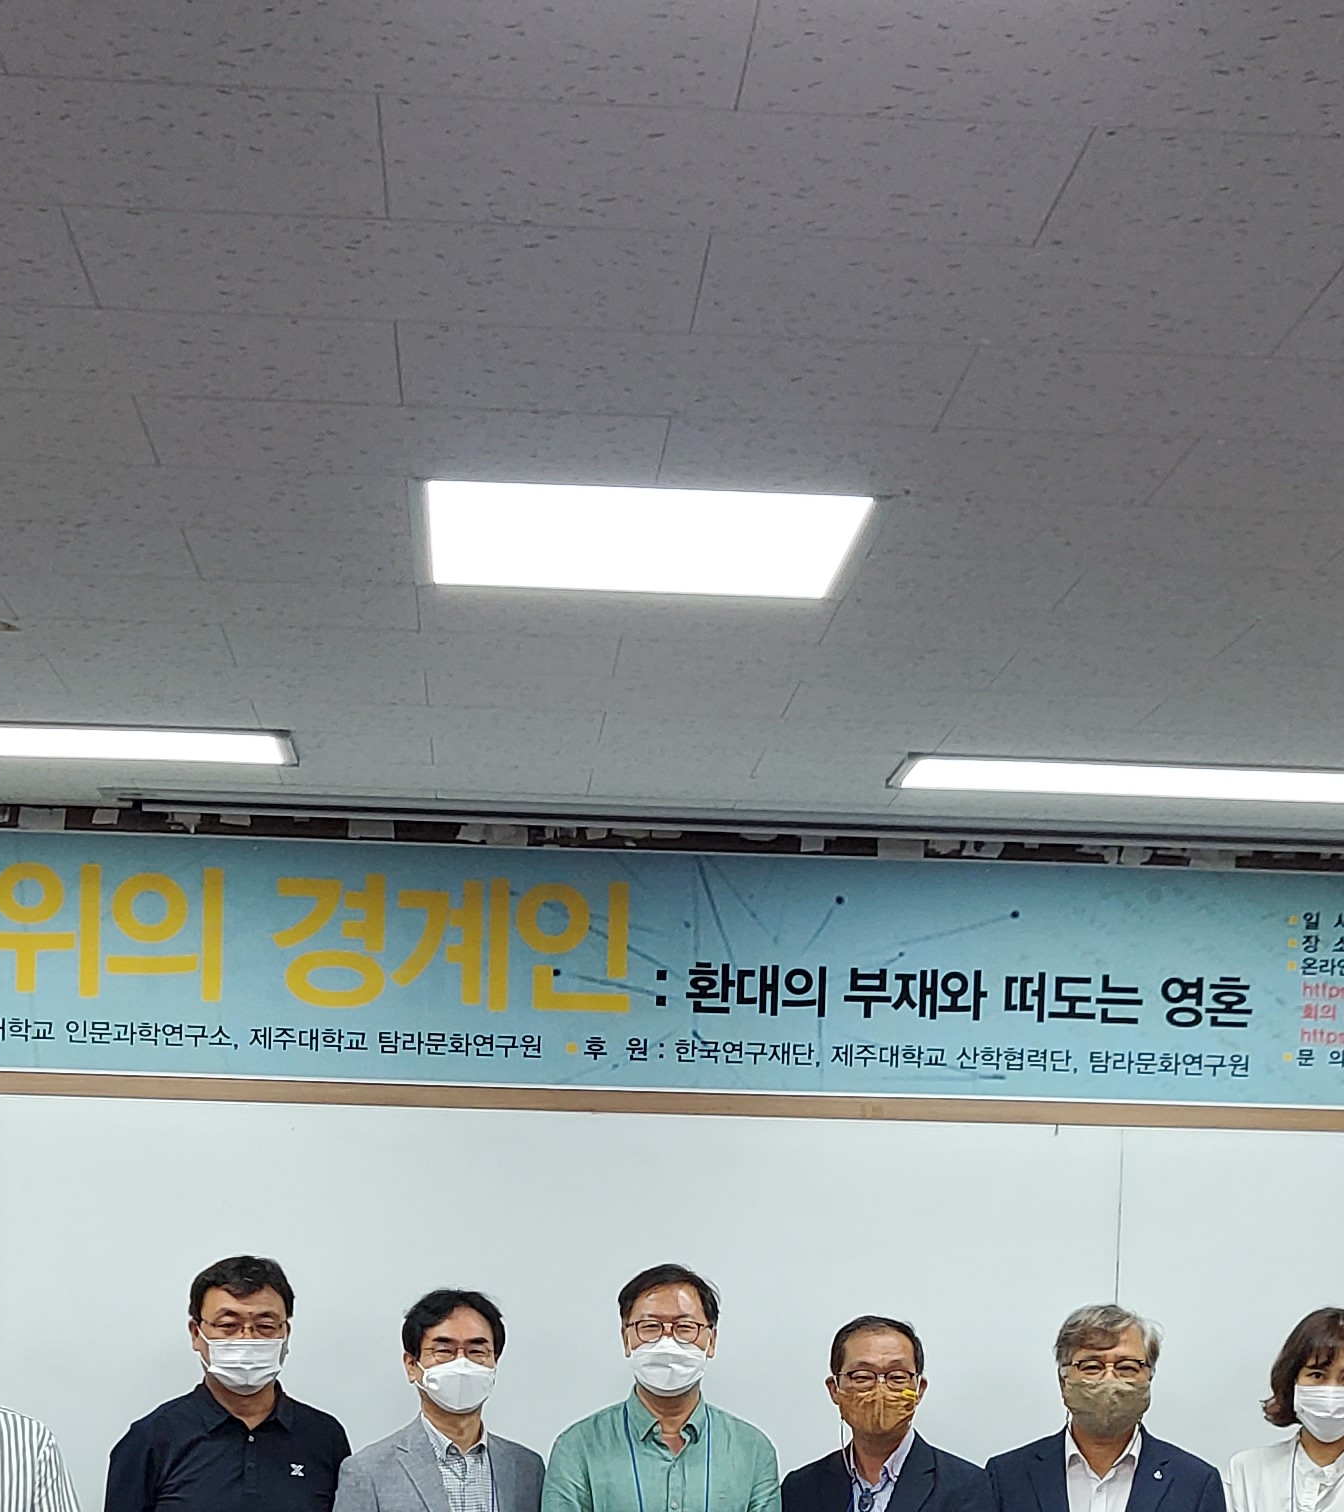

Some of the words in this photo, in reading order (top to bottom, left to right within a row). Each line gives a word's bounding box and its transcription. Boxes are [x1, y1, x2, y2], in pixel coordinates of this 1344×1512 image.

[271, 873, 631, 1014] 경계인
[684, 961, 829, 1018] 환대의
[843, 966, 987, 1022] 부재와
[1004, 970, 1146, 1026] 떠도는
[1161, 975, 1254, 1029] 영혼
[1301, 1003, 1337, 1021] 회의
[65, 1019, 239, 1051] 인문과학연구소,
[249, 1026, 369, 1053] 제주대학교
[378, 1031, 543, 1059] 탐라문화연구원
[674, 1039, 821, 1068] 한국연구재단,
[831, 1043, 947, 1069] 제주대학교
[956, 1047, 1079, 1076] 산학협력단,
[1089, 1050, 1251, 1078] 탐라문화연구원
